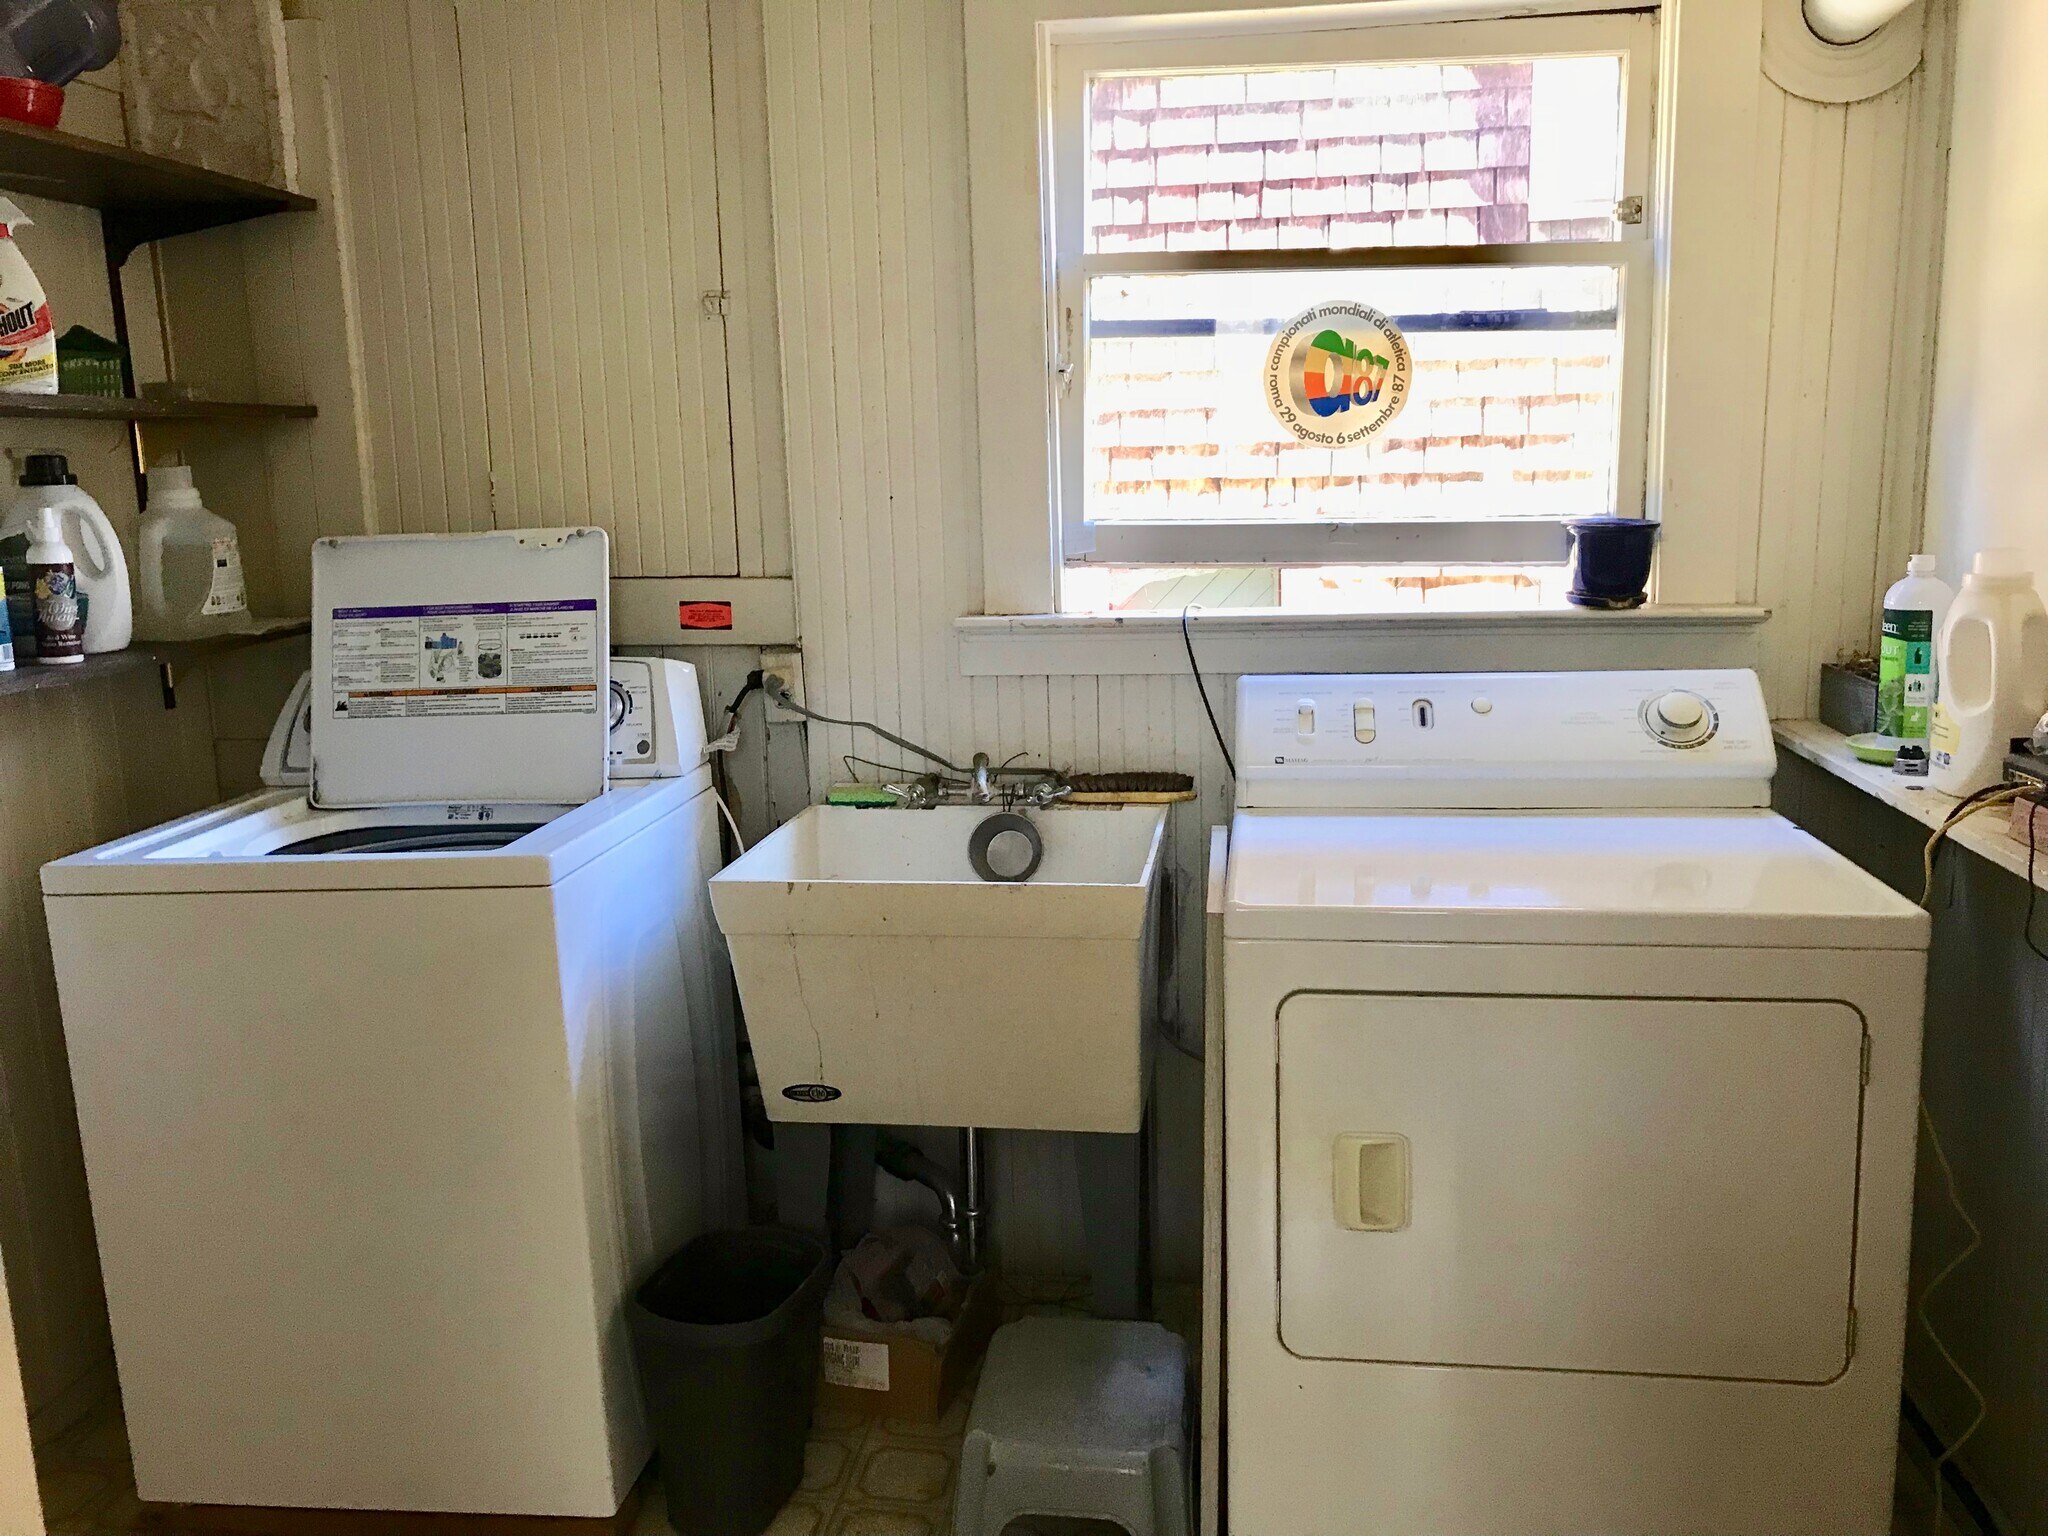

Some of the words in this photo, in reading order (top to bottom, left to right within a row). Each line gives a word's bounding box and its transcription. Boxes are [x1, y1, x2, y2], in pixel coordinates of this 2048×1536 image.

[1271, 308, 1317, 372] campionati
[1318, 303, 1376, 323] mondiali
[1373, 315, 1387, 335] di
[1383, 329, 1406, 372] atletica
[1269, 374, 1283, 409] roma
[1279, 406, 1297, 424] 29
[1293, 422, 1334, 444] agosto
[1336, 432, 1346, 444] 6
[1347, 396, 1400, 443] settembre
[1392, 374, 1406, 393] 87
